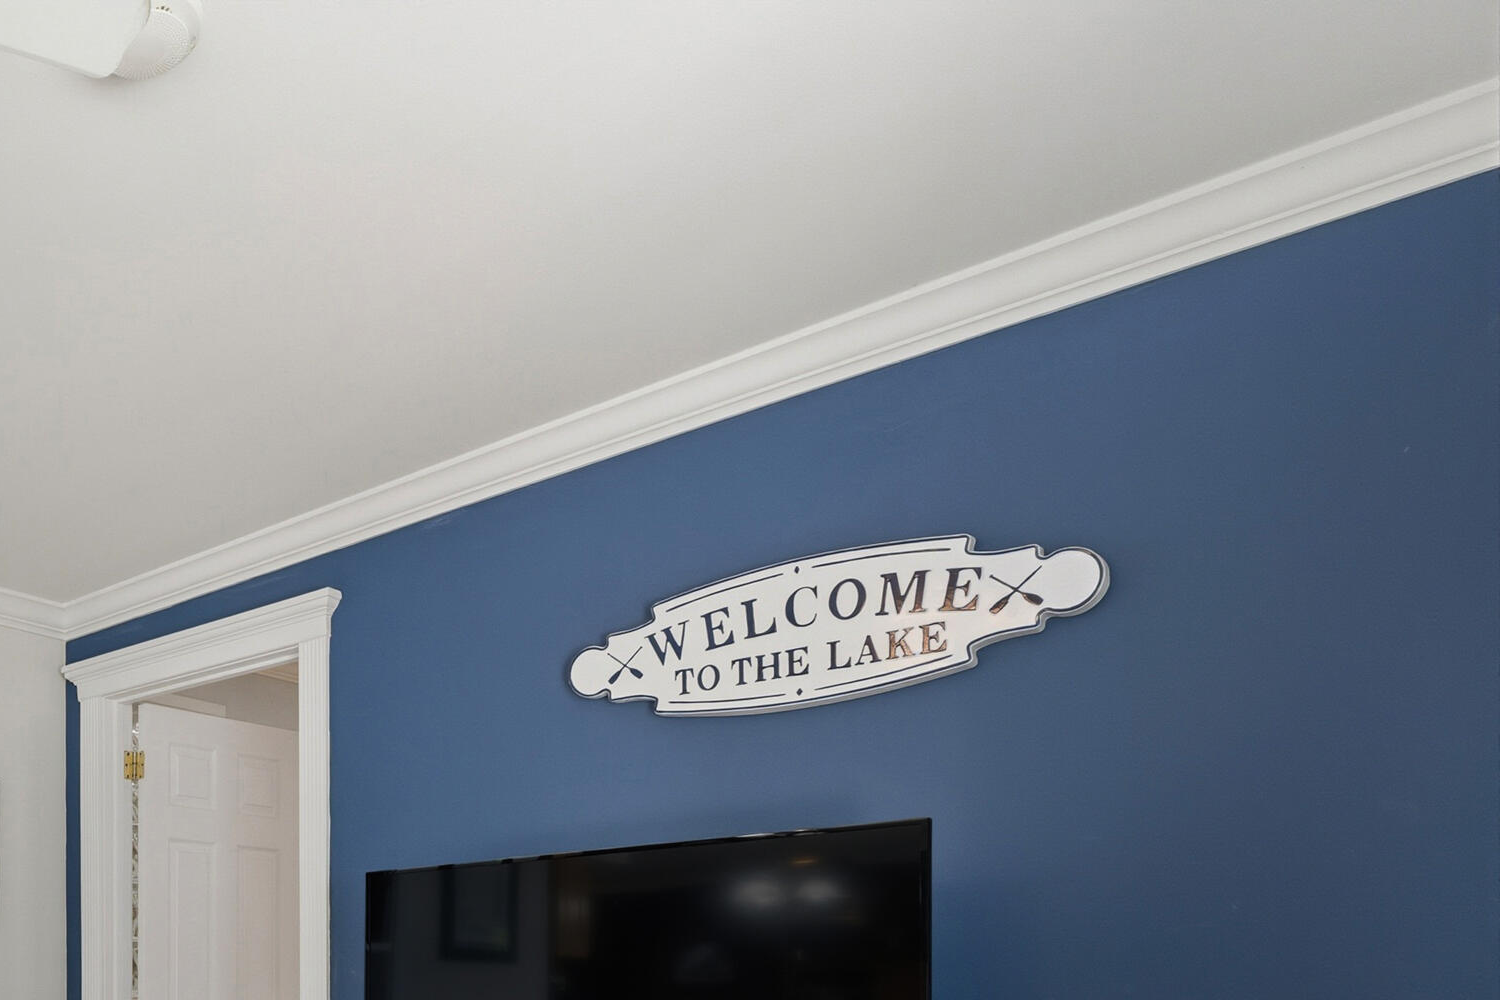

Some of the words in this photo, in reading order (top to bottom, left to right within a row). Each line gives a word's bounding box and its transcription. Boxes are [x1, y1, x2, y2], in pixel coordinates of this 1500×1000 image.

[645, 566, 984, 667] WELCOME
[675, 665, 720, 695] TO
[731, 646, 810, 686] THE
[827, 621, 948, 671] LAKE
